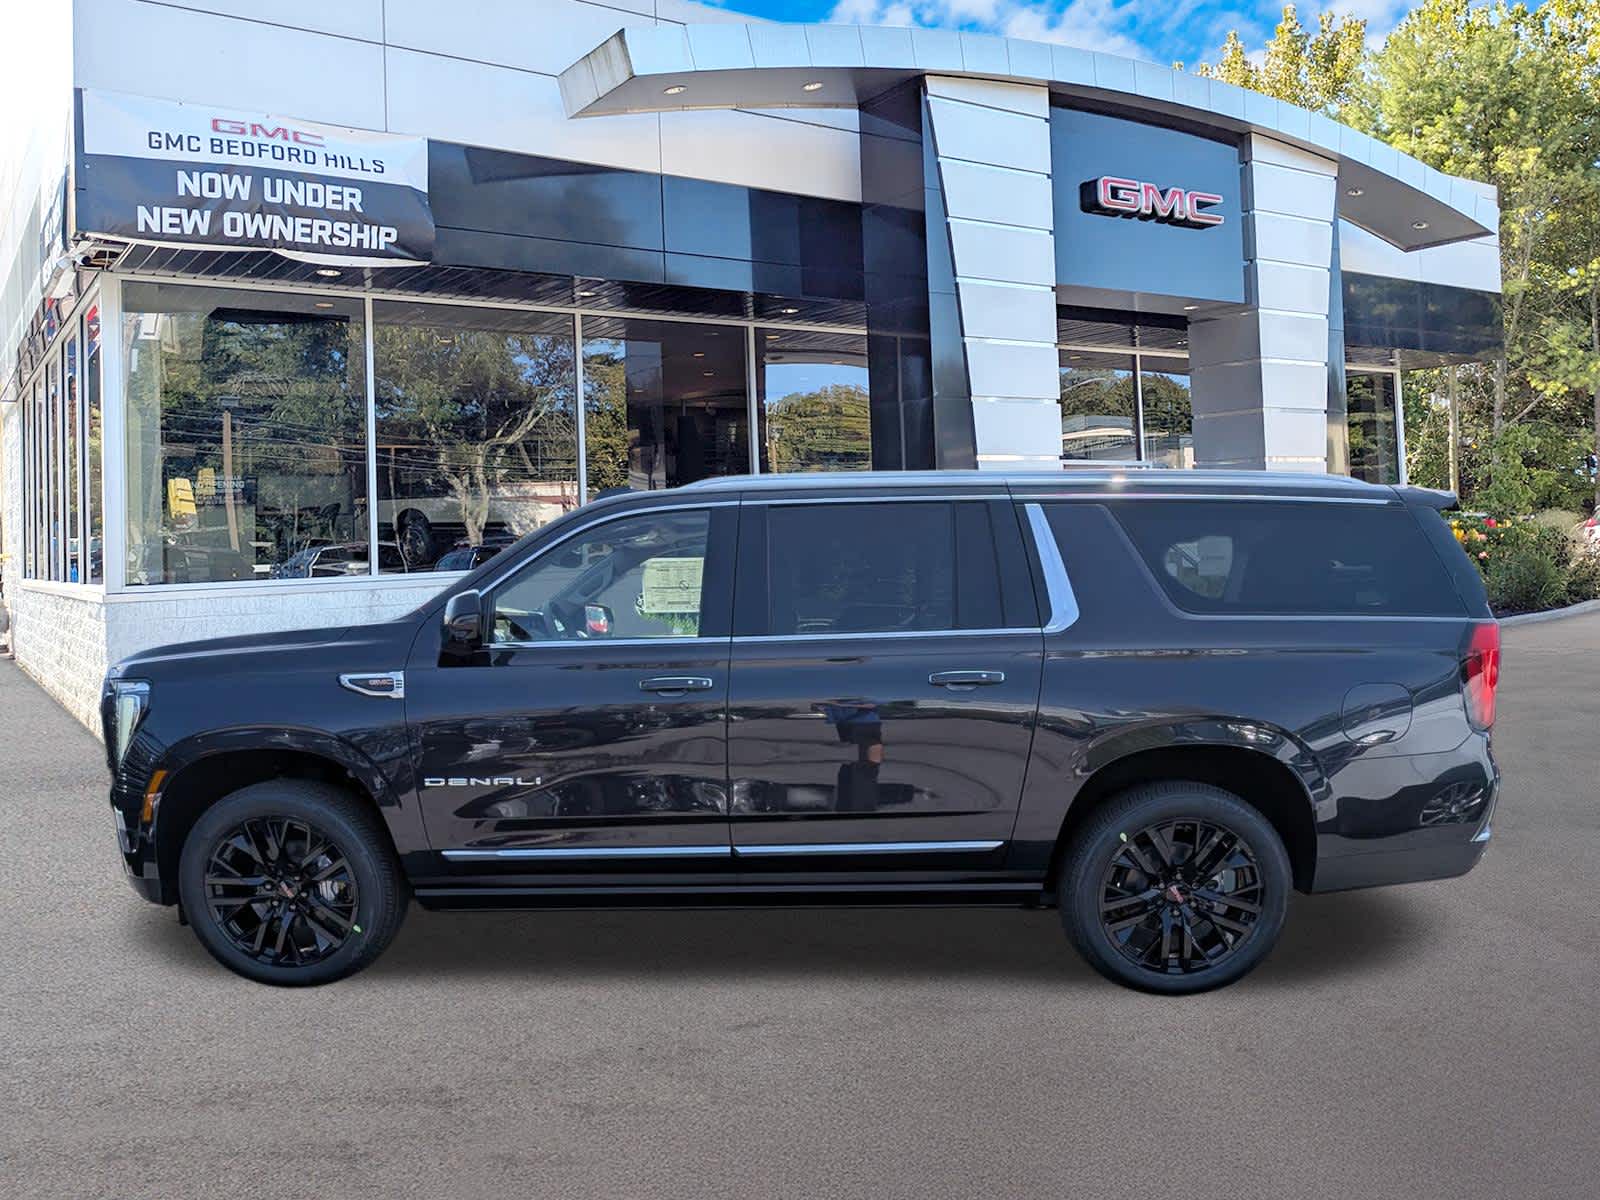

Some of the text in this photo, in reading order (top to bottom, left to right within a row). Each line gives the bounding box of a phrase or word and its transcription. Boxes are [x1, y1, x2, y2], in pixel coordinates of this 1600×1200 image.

[148, 131, 385, 174] GMC BEDFORD HILLS
[211, 117, 326, 148] GMC
[177, 170, 364, 213] NOW UNDER
[1098, 176, 1224, 225] GMC
[136, 205, 398, 250] NEW OWNERSHIP
[423, 776, 542, 786] DENALI
